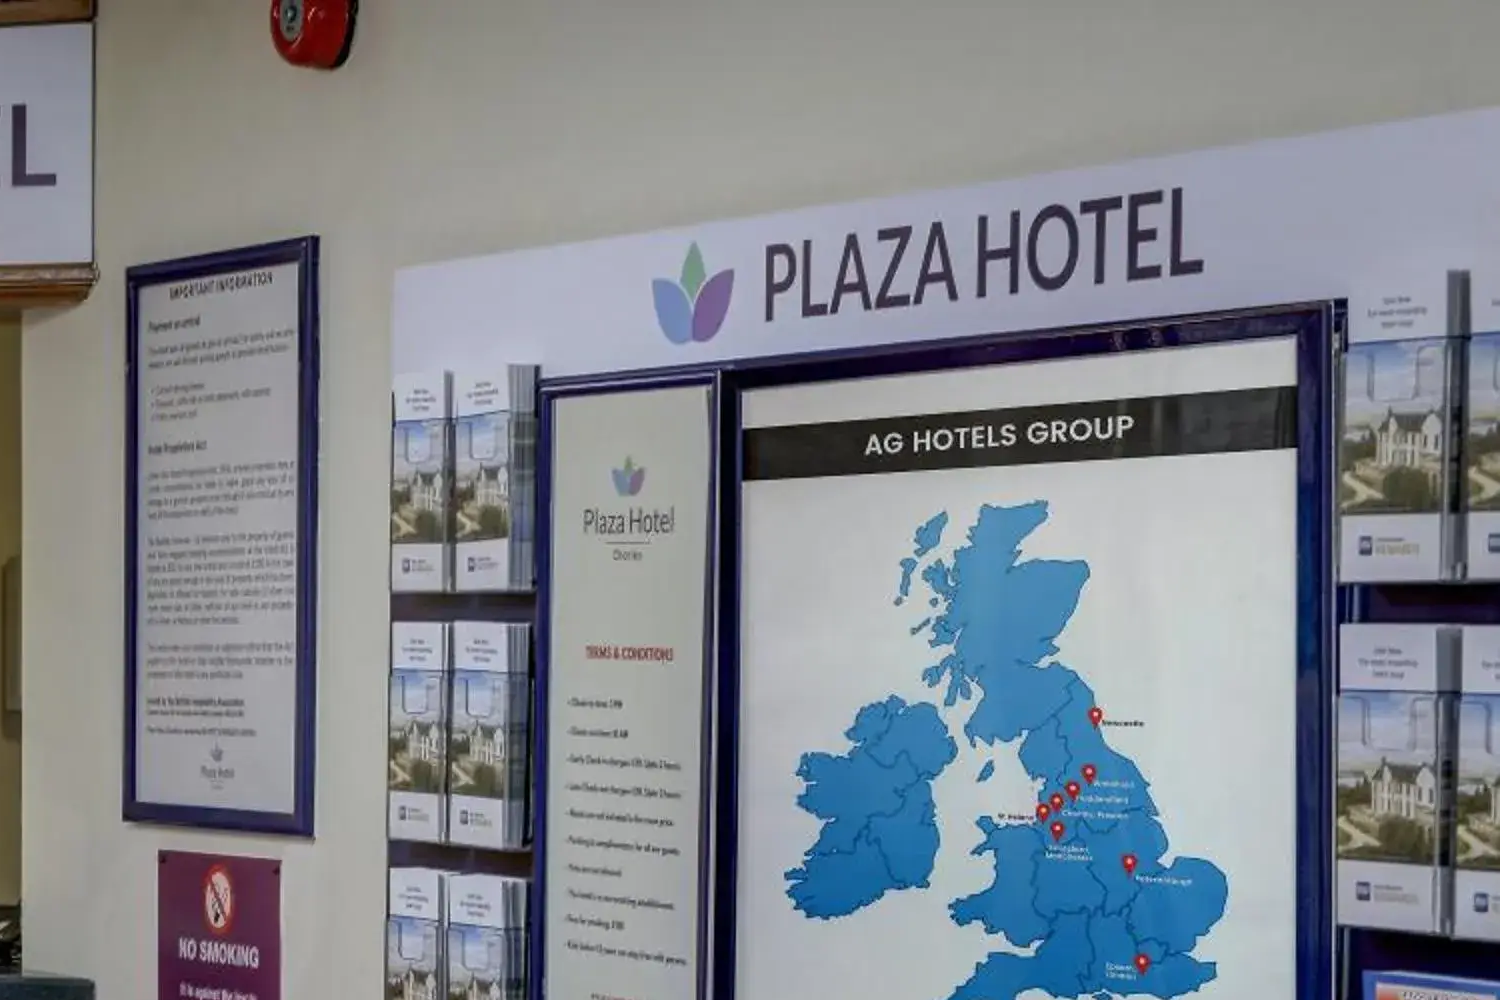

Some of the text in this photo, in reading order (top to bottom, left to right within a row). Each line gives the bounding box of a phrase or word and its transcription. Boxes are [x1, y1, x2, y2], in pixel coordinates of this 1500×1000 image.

[765, 187, 1204, 323] PLAZA HOTEL
[169, 271, 274, 301] IMPORTANT INFORMATION
[864, 414, 1135, 456] AG HOTELS GROUP
[583, 505, 676, 535] Plaza Hotel
[585, 645, 612, 660] TERMS
[620, 645, 674, 661] CONDITIONS
[178, 936, 260, 970] NO SMOKING
